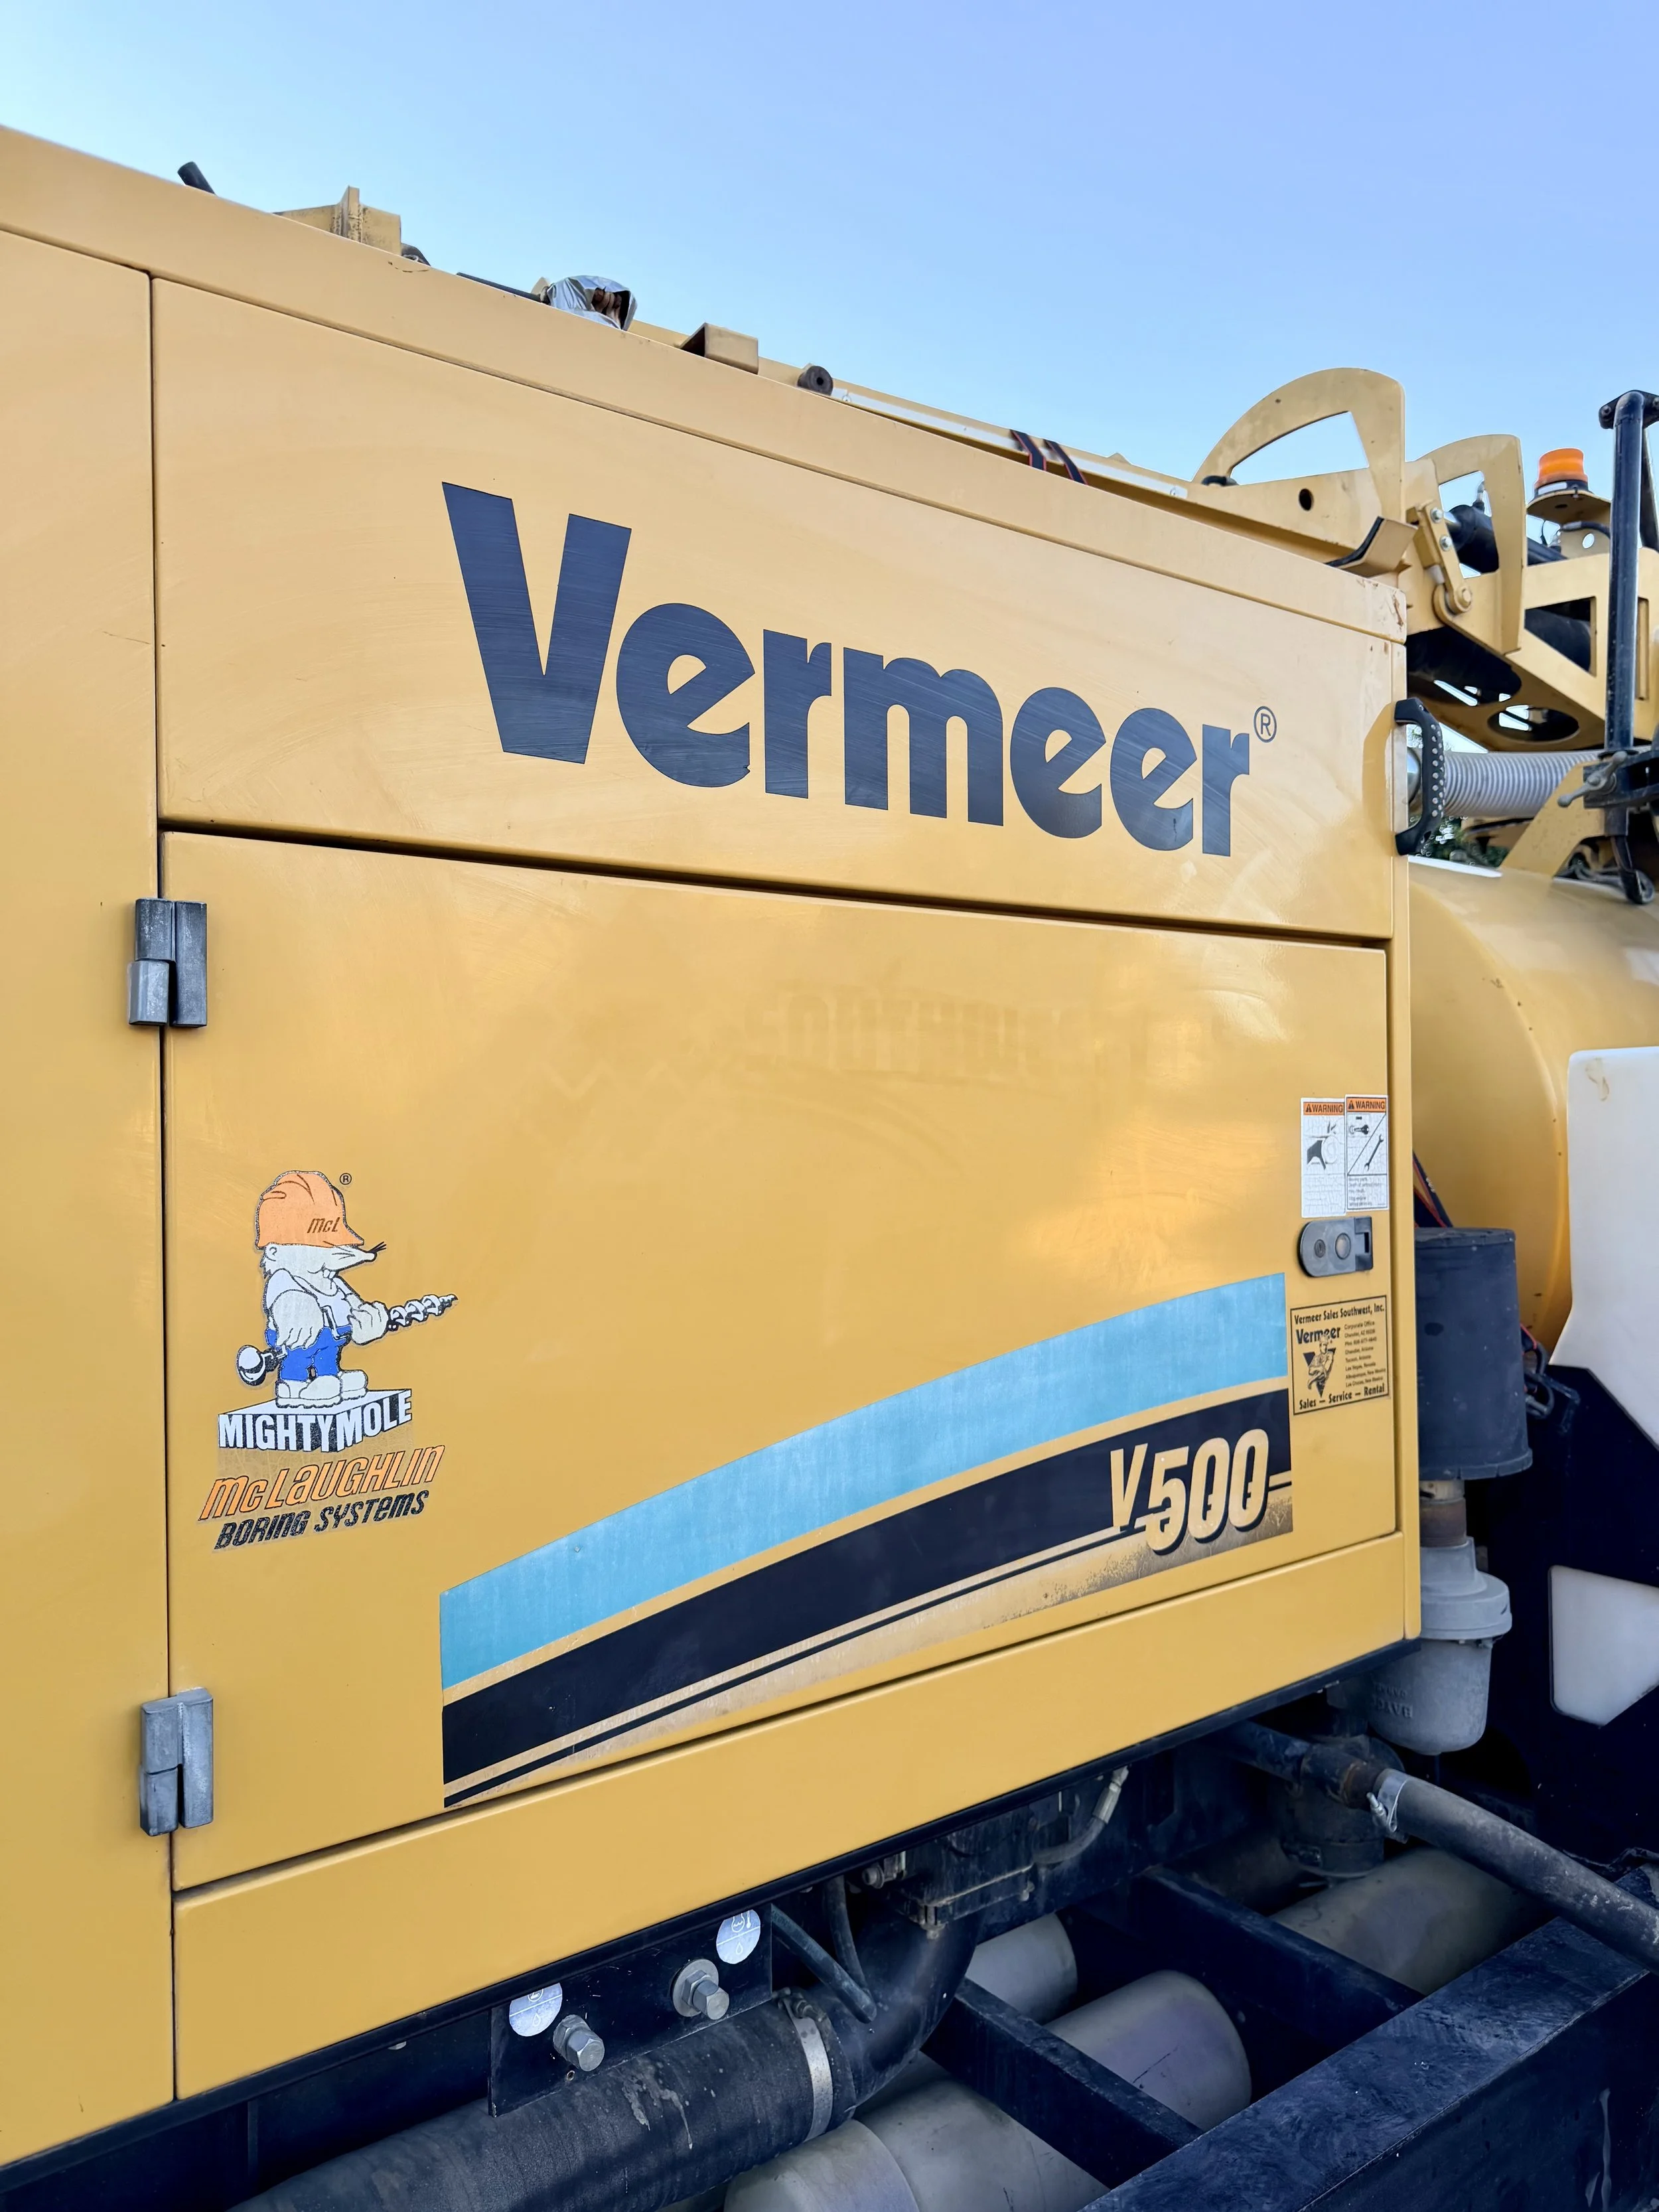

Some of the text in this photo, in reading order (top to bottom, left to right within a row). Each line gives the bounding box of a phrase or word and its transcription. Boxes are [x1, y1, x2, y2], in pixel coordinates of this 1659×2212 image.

[1312, 1104, 1344, 1114] WARNING
[1356, 1100, 1386, 1110] WARNING
[1294, 1303, 1385, 1325] Vermeer Sales Southwest, Inc.
[1299, 1398, 1317, 1410] Sales
[1329, 1390, 1352, 1404] Service
[1364, 1382, 1385, 1396] Rental
[218, 1388, 412, 1452] MIGHTY MOLE
[1110, 1428, 1270, 1554] V500
